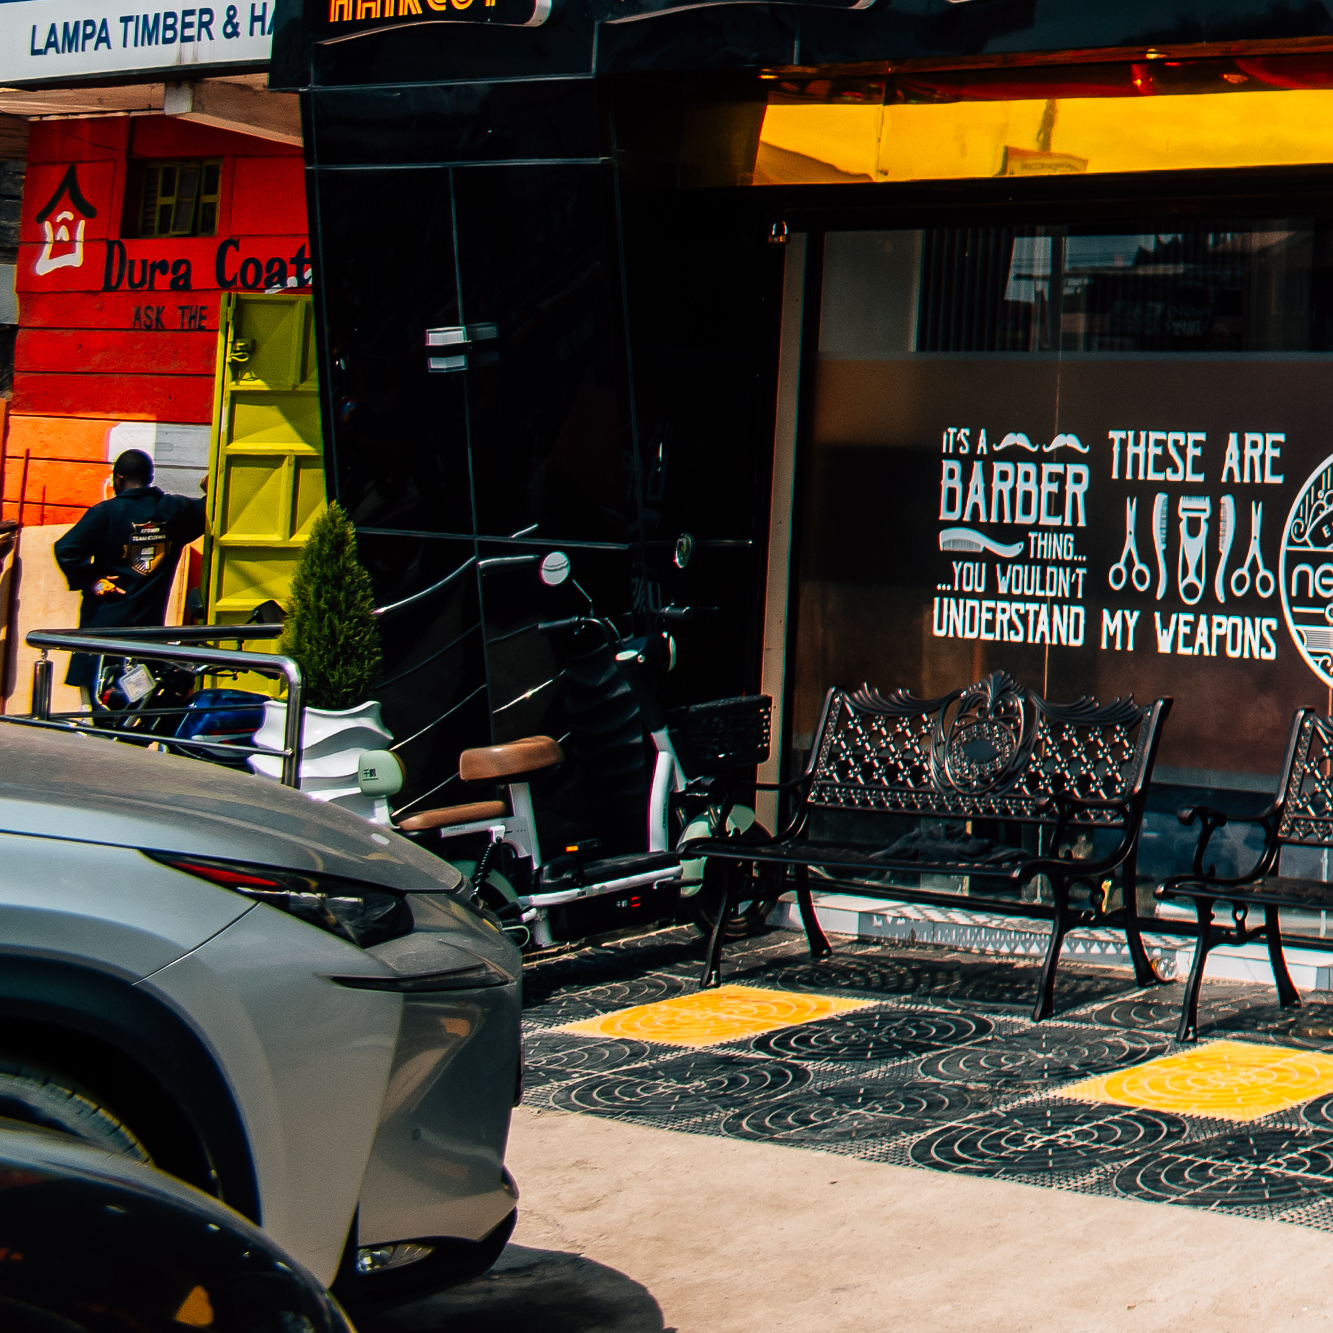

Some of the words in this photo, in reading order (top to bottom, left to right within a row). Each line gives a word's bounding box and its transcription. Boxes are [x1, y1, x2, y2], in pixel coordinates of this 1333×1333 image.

[30, 17, 111, 57] LAMPA
[119, 7, 215, 48] TIMBER
[222, 4, 241, 39] &
[102, 239, 192, 291] Dura
[215, 238, 312, 290] Coat
[132, 305, 166, 330] ASK
[178, 305, 208, 330] THE
[942, 427, 970, 454] IT'S
[976, 428, 988, 455] A
[1108, 430, 1206, 482] THESE
[1221, 433, 1285, 484] ARE
[938, 459, 1089, 527] BARBER
[1028, 531, 1087, 561] THING...
[936, 561, 986, 592] ...YOU
[996, 563, 1087, 598] WOULDN'T
[932, 597, 1085, 646] UNDERSTAND
[1101, 609, 1140, 651] MY
[1154, 611, 1278, 661] WEAPONS
